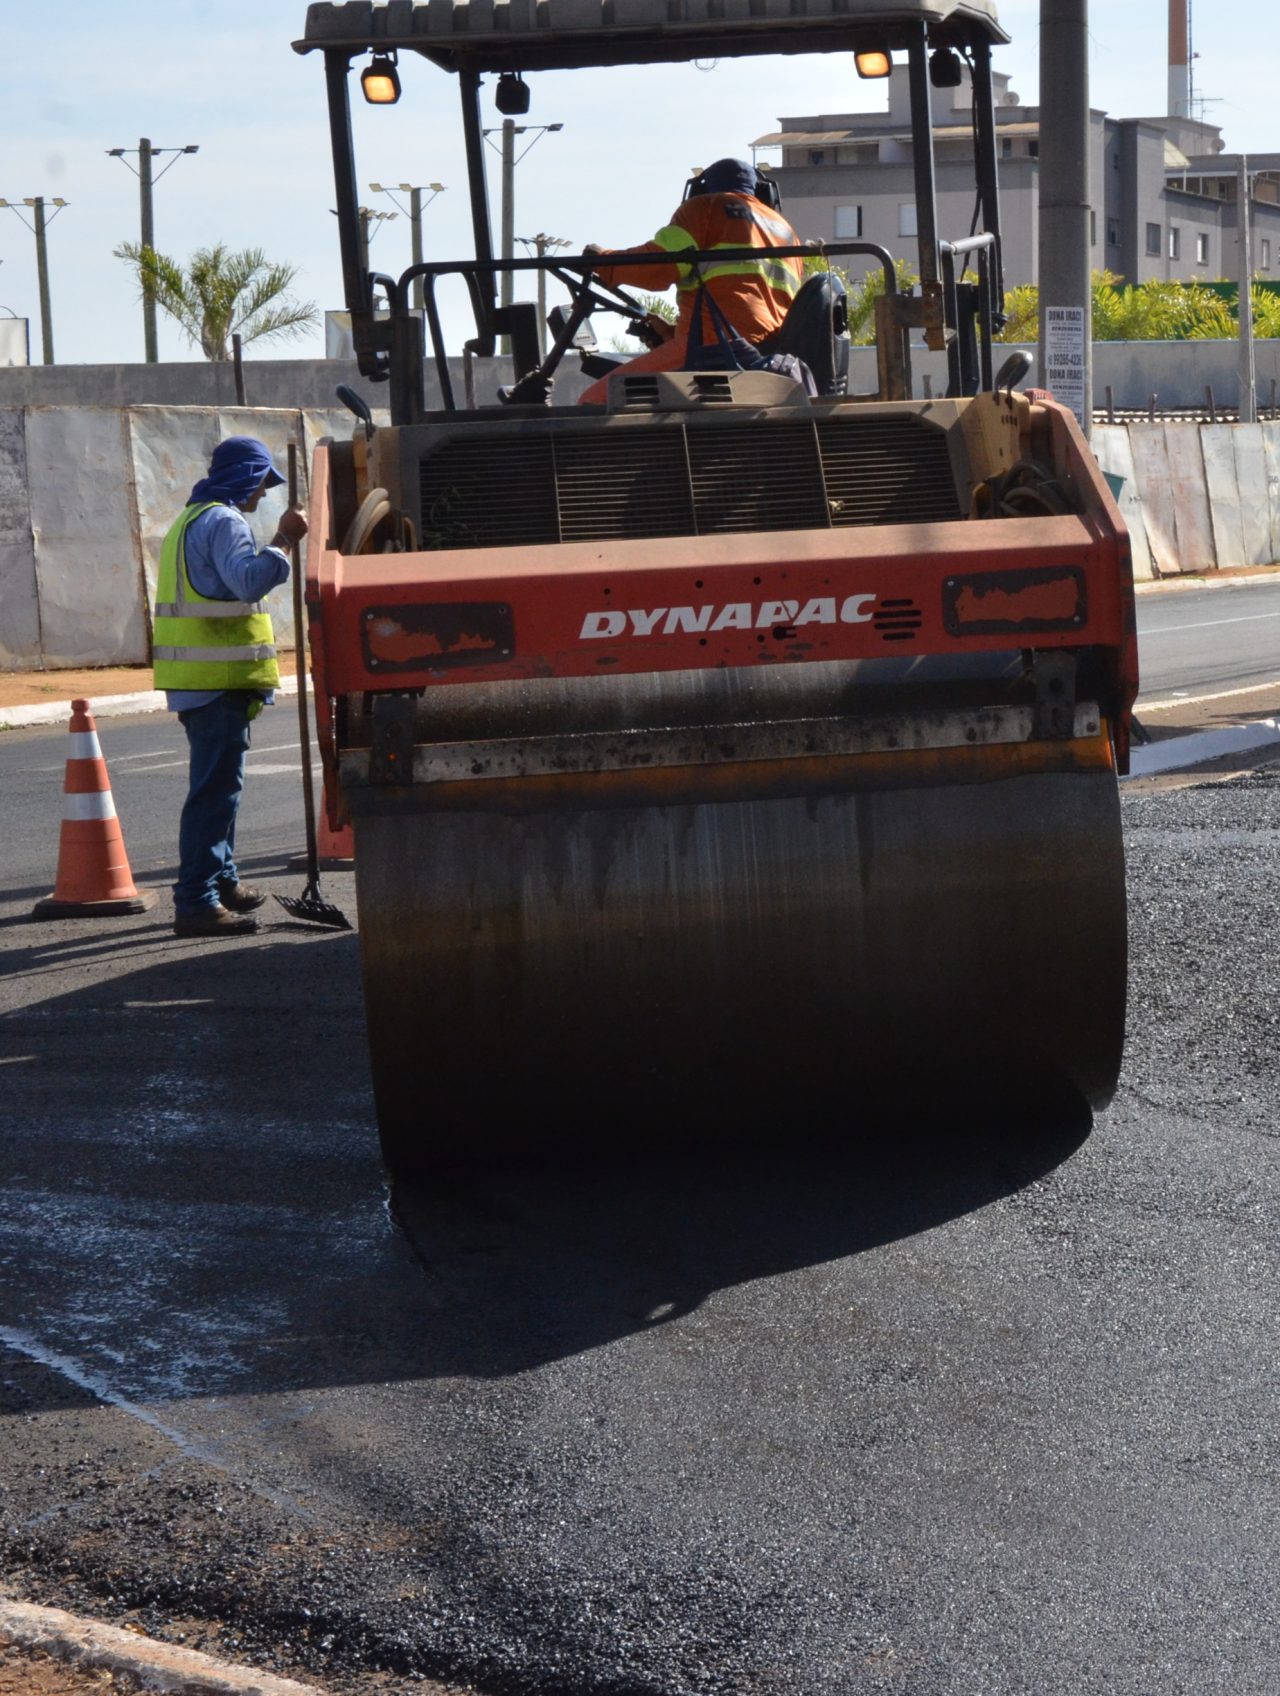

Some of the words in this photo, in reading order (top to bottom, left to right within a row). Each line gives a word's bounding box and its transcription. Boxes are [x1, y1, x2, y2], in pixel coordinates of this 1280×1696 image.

[1049, 311, 1064, 321] DONA
[1049, 369, 1065, 380] DONA
[1066, 369, 1083, 380] IRACI
[578, 593, 877, 639] DYNAPAC
